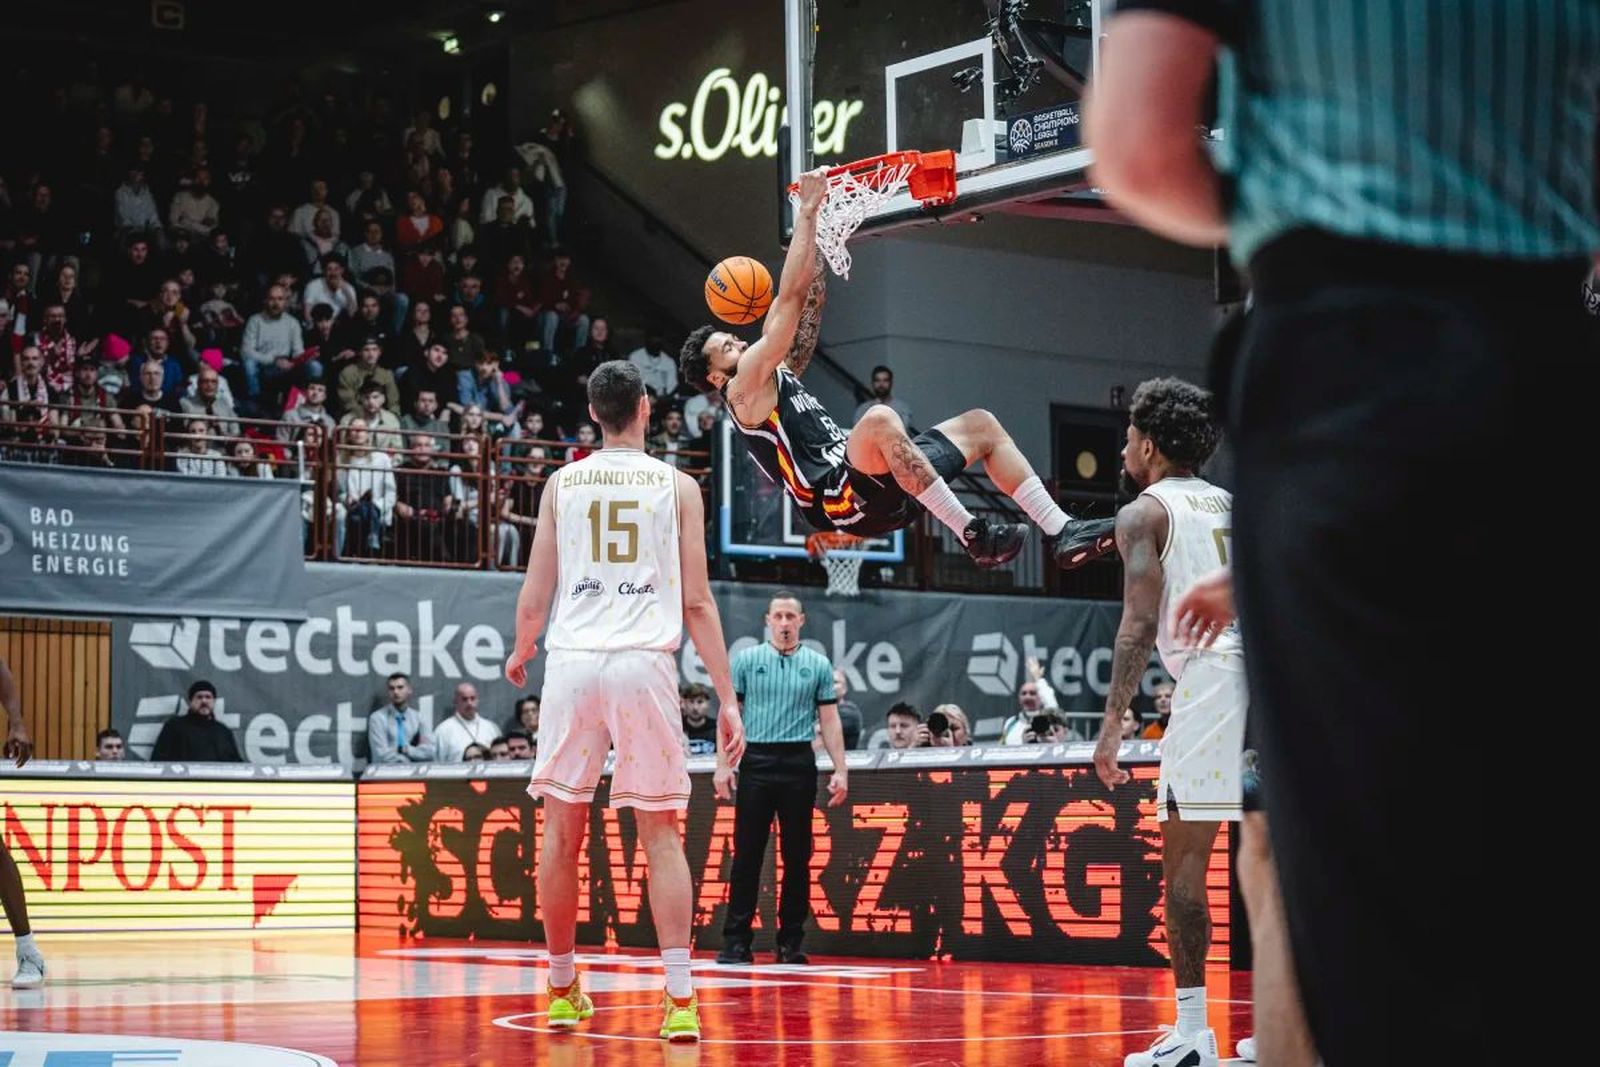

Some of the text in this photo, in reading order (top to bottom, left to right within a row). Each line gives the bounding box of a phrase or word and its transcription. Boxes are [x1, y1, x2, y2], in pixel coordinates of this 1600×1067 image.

[654, 67, 864, 162] s.Olier
[1033, 107, 1074, 123] BASKETBALL
[1033, 114, 1080, 133] CHAMPIONS
[1033, 128, 1059, 141] LEAGUE
[30, 507, 74, 527] BAD
[31, 530, 130, 553] HEIZUNG
[588, 500, 639, 563] 15
[31, 554, 129, 577] ENERGIE
[208, 599, 505, 681] tectake
[961, 800, 1122, 938] KG
